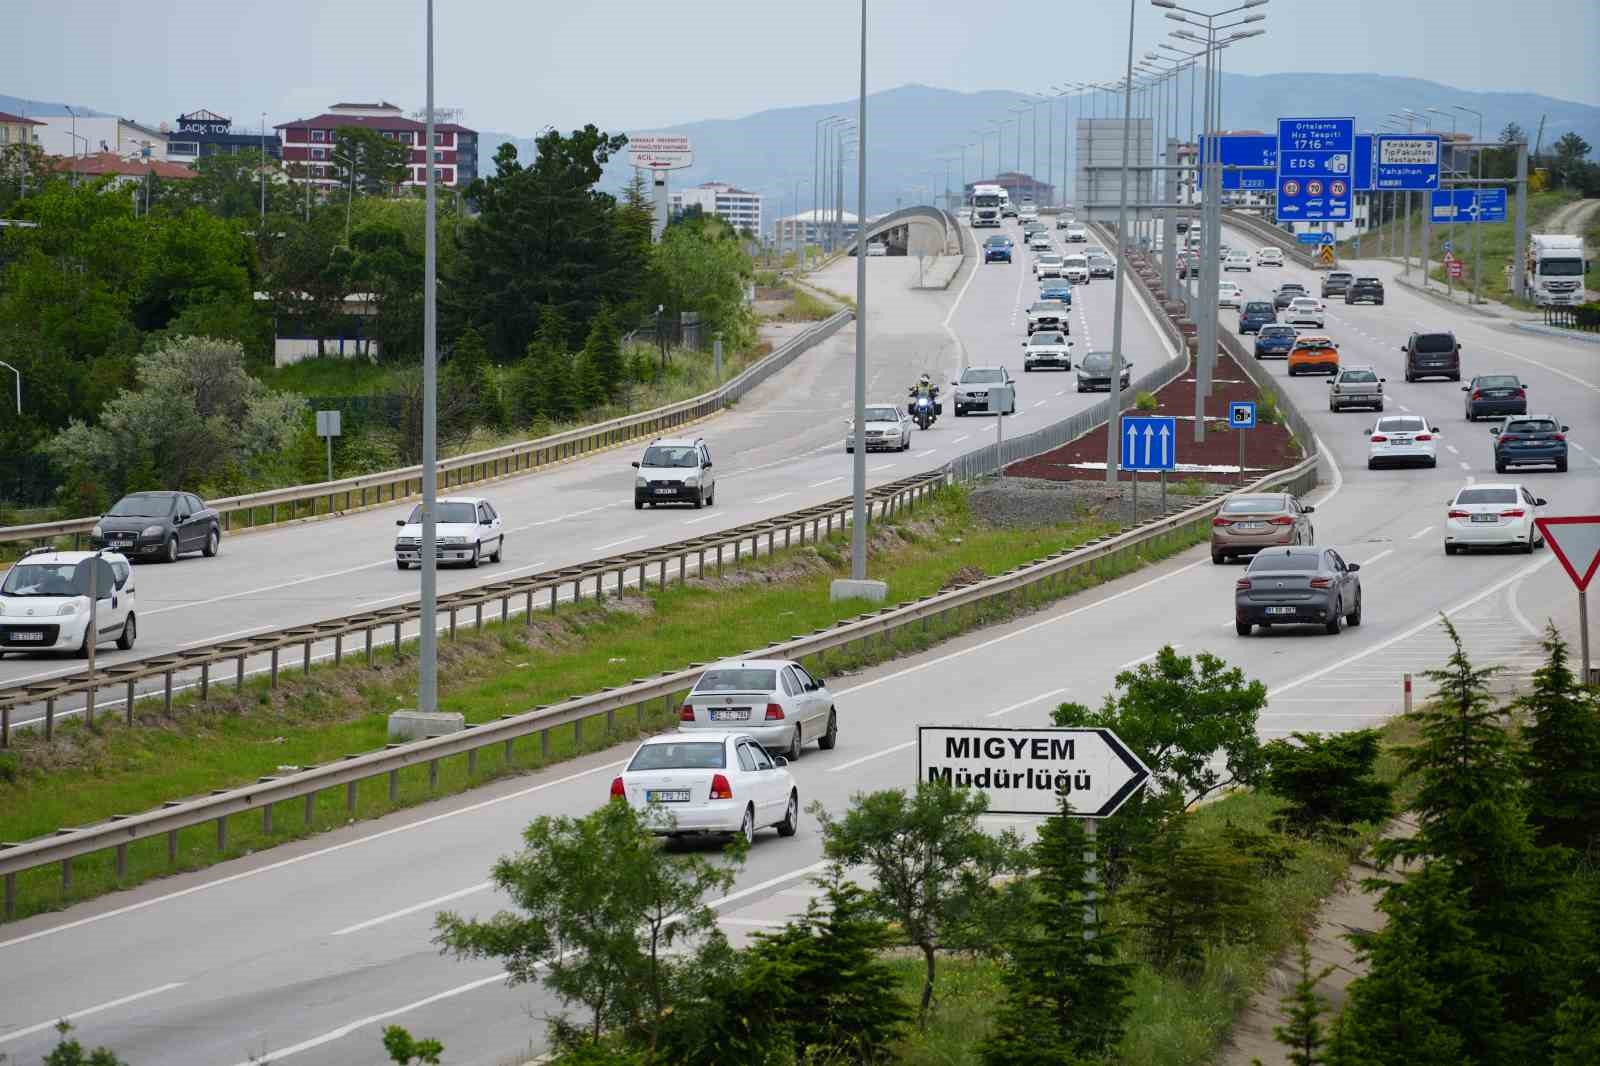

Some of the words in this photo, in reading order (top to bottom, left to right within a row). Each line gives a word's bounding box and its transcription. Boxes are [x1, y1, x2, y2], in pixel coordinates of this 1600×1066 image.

[1295, 140, 1321, 149] 1716
[1290, 159, 1316, 168] EDS
[946, 737, 1075, 760] MIGYEM
[928, 766, 1091, 796] Müdürlüğü
